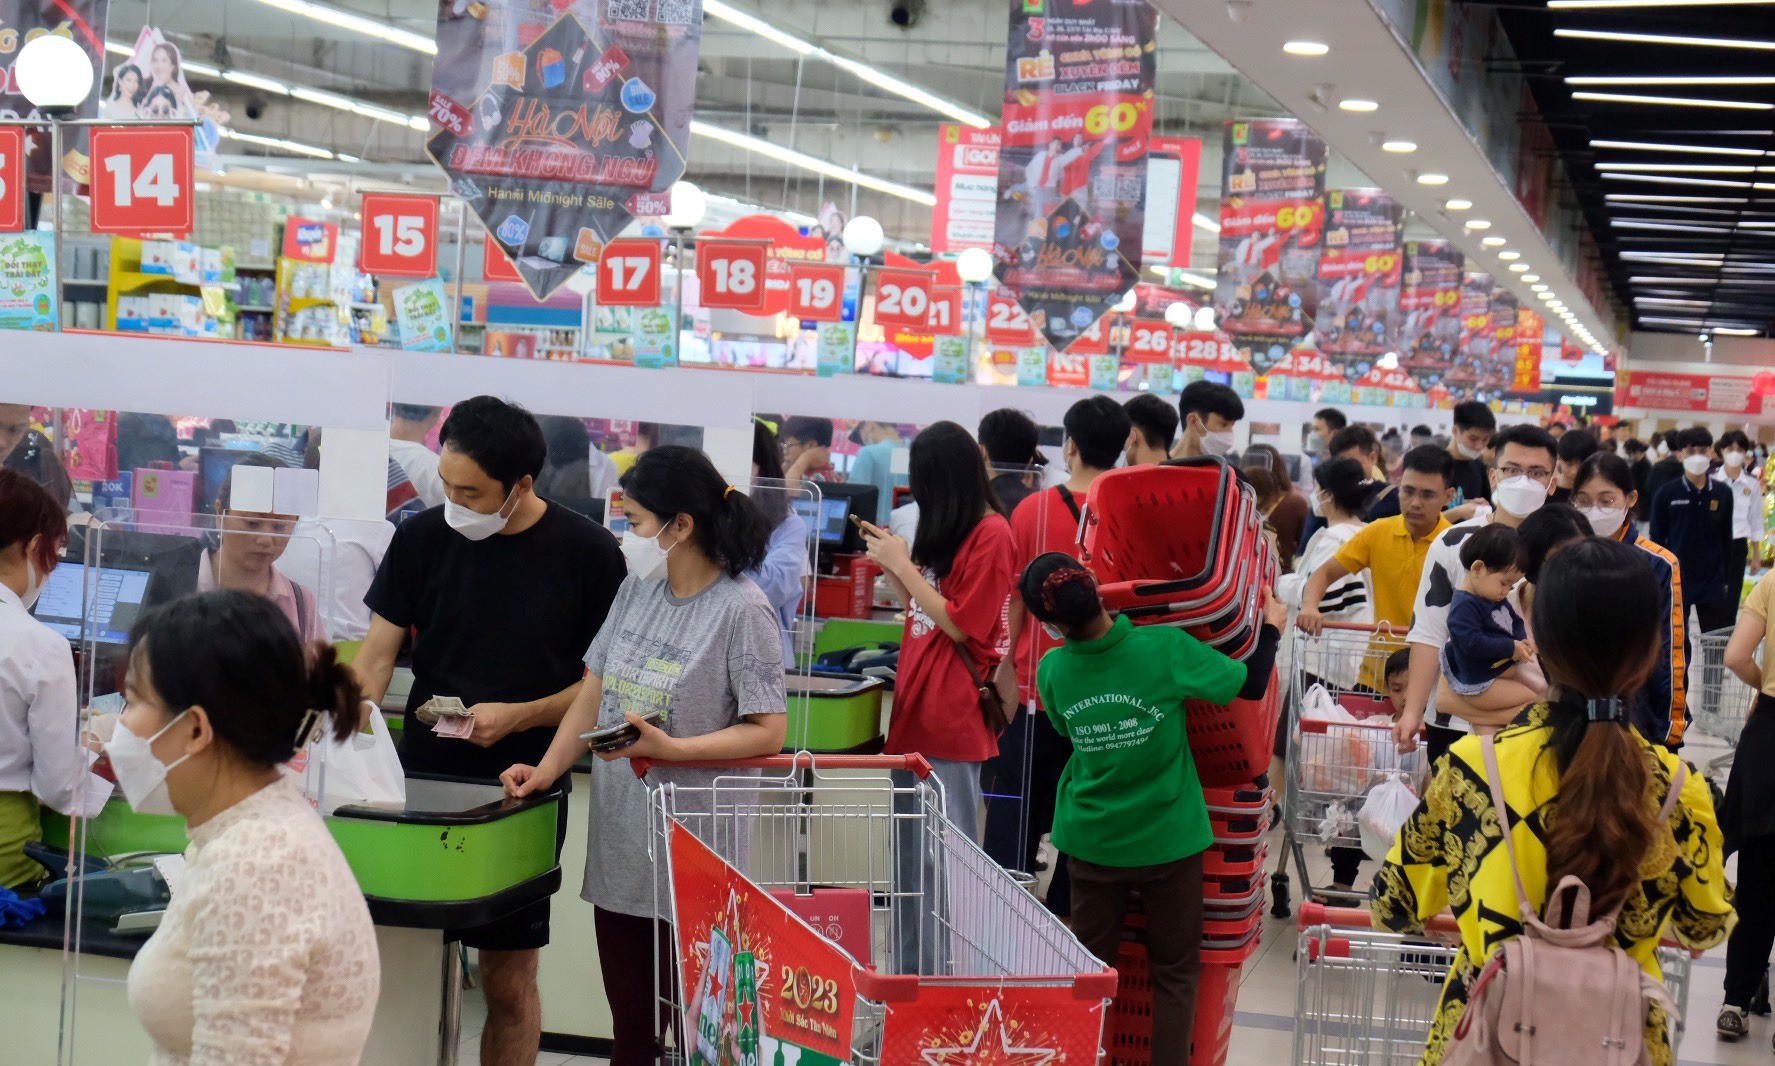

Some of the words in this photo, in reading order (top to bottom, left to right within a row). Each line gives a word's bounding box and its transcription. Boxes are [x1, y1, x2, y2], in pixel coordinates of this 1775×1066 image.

[1054, 82, 1096, 95] BLACK
[1097, 79, 1139, 91] FRIDAY
[429, 99, 462, 132] 70%
[104, 153, 179, 207] 14
[373, 214, 426, 258] 15
[606, 256, 651, 291] 17
[711, 258, 756, 294] 18
[797, 278, 836, 309] 19
[878, 284, 928, 317] 20
[989, 303, 1030, 331] 22
[1134, 328, 1168, 352] 26
[1189, 339, 1219, 361] 28
[102, 482, 123, 493] 20K
[1075, 725, 1092, 736] ISO
[1092, 722, 1111, 734] 9001
[1118, 717, 1139, 731] 2008
[1147, 705, 1165, 722] JSC
[1071, 735, 1085, 744] ake
[1096, 733, 1116, 743] world
[1117, 732, 1136, 741] more
[781, 964, 838, 1014] 2023
